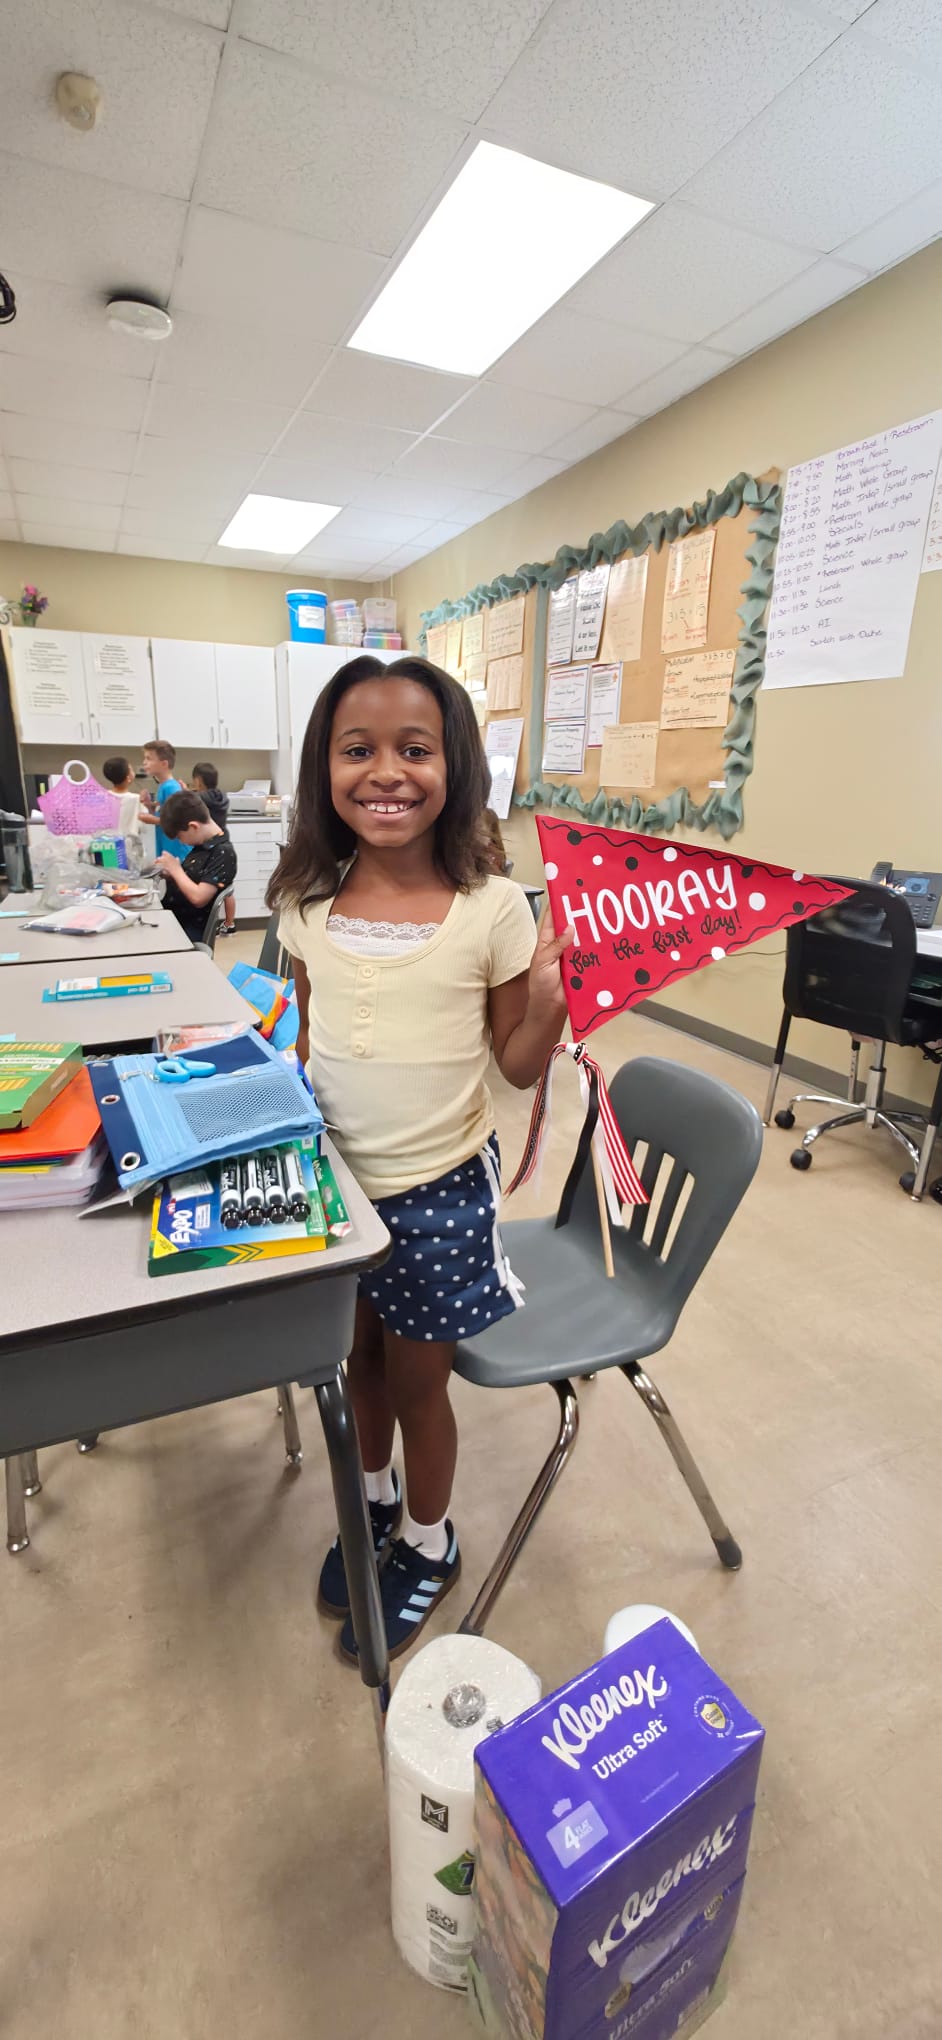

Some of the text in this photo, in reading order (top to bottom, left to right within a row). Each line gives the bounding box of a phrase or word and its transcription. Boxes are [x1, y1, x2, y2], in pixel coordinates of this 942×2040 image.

[834, 472, 853, 484] Math
[833, 486, 854, 497] Math
[831, 500, 851, 511] Math
[822, 550, 854, 565] Science
[819, 581, 841, 593] Lunch
[815, 597, 844, 609] Science
[561, 865, 738, 947] HOORAY
[568, 910, 742, 974] for the first day!
[542, 1665, 668, 1770] Kleenex
[592, 1719, 668, 1779] Ultra Soft
[565, 1825, 581, 1848] 4
[587, 1815, 737, 1968] Kleenex
